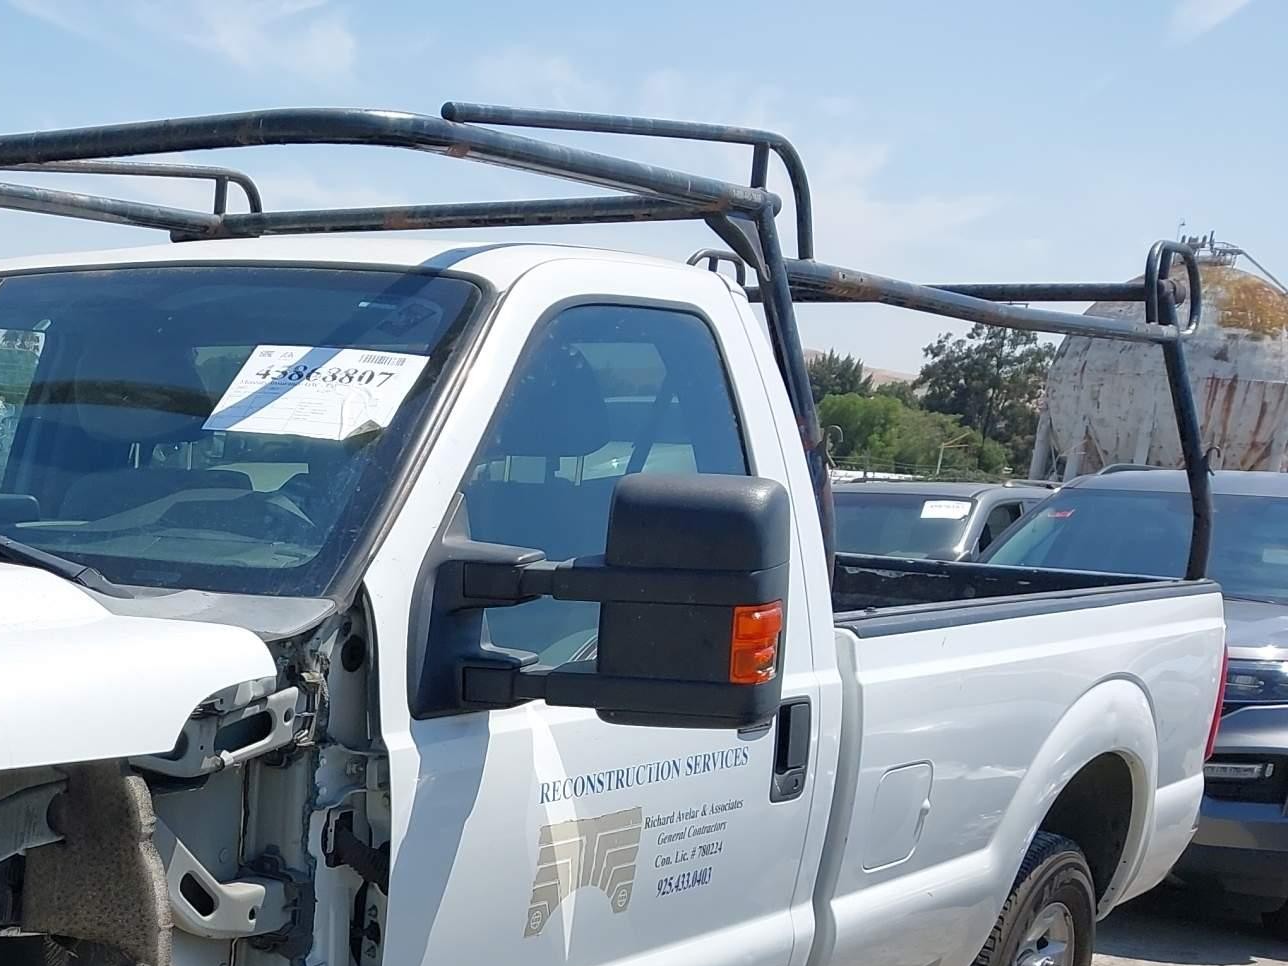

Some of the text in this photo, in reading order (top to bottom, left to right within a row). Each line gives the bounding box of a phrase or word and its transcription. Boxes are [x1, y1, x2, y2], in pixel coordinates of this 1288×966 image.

[539, 746, 750, 804] RECONSTRUCTION SERVICES
[644, 799, 744, 830] Richard Avelar & Associates
[657, 821, 728, 846] General Contractors
[654, 854, 673, 868] Con.
[674, 849, 689, 864] Lic.
[690, 846, 697, 860] #
